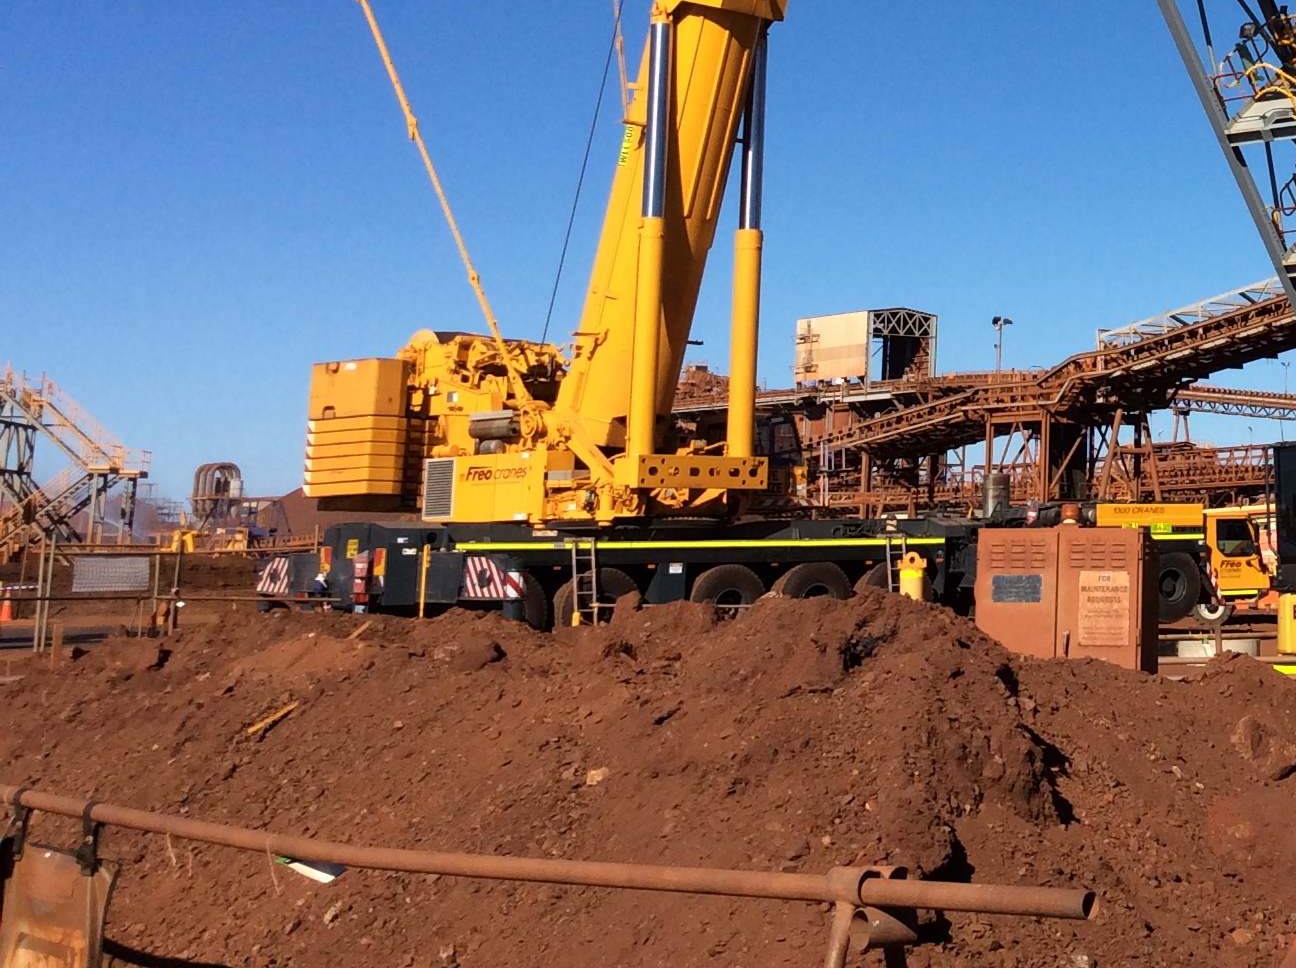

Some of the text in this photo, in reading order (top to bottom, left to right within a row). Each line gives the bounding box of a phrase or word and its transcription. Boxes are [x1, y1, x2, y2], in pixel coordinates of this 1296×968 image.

[466, 466, 527, 481] Freo cranes
[1132, 506, 1165, 514] CRANES
[1220, 560, 1242, 568] Freo
[1080, 585, 1128, 593] MAINTENANCE
[1086, 595, 1122, 603] REQUESTS
